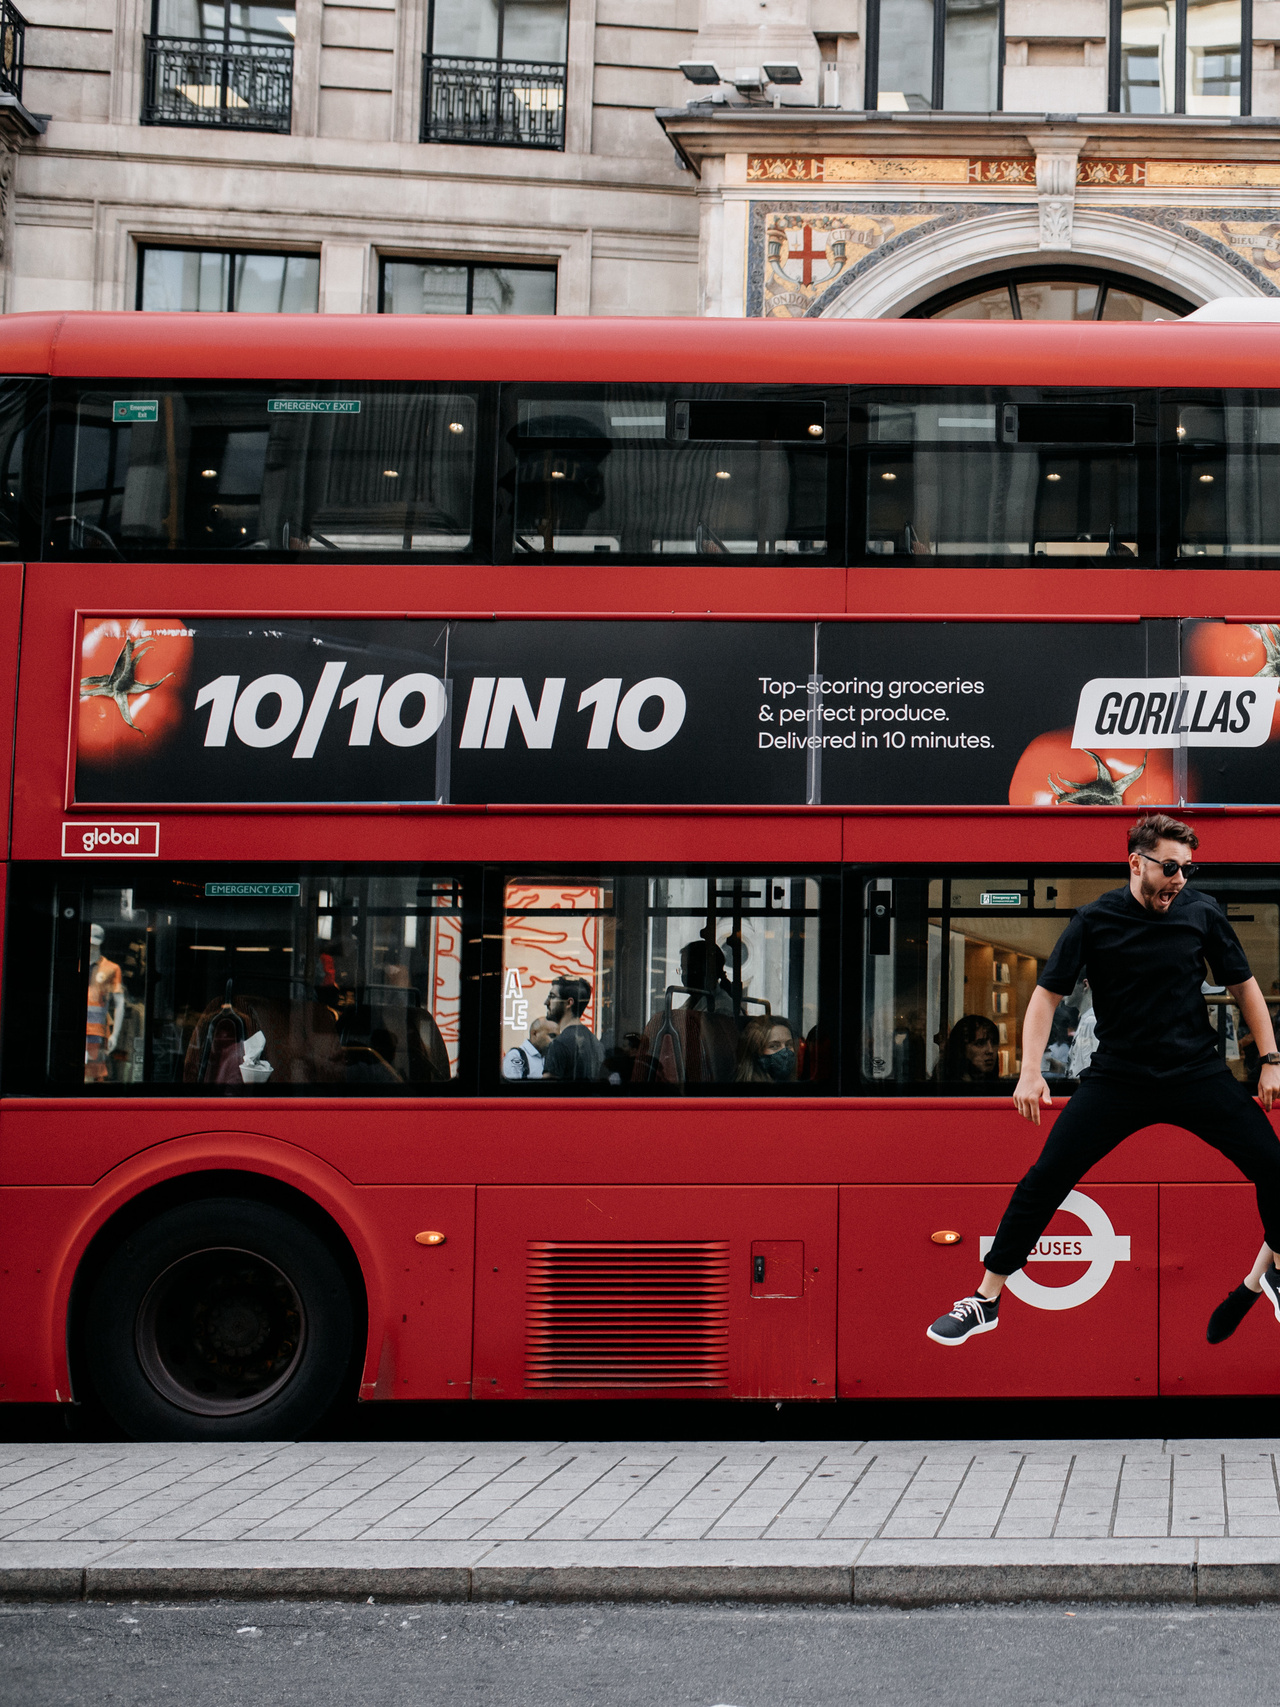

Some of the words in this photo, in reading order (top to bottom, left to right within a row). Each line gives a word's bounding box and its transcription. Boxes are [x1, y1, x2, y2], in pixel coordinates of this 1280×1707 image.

[832, 230, 856, 241] CITY
[1266, 240, 1280, 251] ET
[765, 293, 815, 309] LONDON
[273, 401, 332, 411] EMERGENCY
[333, 402, 354, 411] EXIT
[758, 677, 884, 699] Top-scoring
[888, 677, 985, 699] groceries
[195, 661, 448, 759] 10/10
[459, 677, 566, 749] IN
[577, 677, 687, 751] 10
[758, 704, 775, 722] &
[779, 704, 856, 726] perfect
[860, 704, 950, 726] produce.
[1094, 690, 1257, 736] GORILLAS
[758, 731, 857, 749] Delivered
[861, 731, 878, 749] in
[882, 732, 906, 749] 10
[910, 731, 995, 749] minutes.
[82, 828, 140, 852] global
[211, 885, 270, 894] EMERGENCY
[272, 885, 294, 894] EXIT
